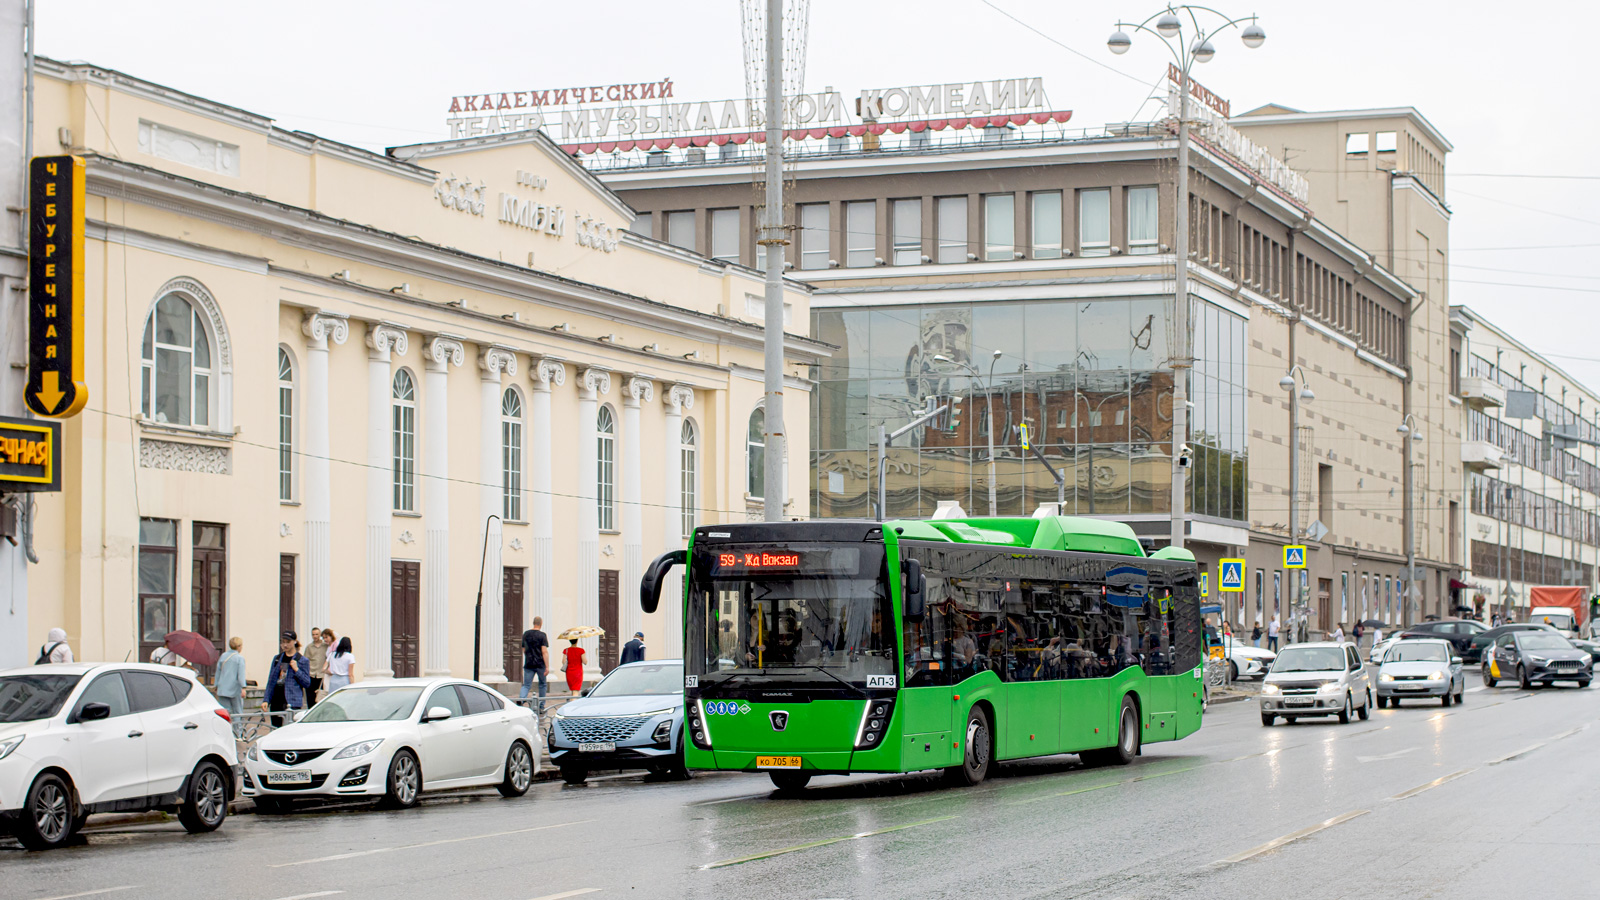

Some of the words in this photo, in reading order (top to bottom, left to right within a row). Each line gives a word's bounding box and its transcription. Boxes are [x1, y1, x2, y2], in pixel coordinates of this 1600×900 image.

[448, 77, 674, 112] АКАДЕМИЧЕСКИЙ
[860, 77, 1043, 118] КОМЕДИИ
[45, 162, 57, 359] ЧЕБУРЕЧНАЯ
[720, 554, 735, 566] 59
[745, 553, 760, 567] Жд
[762, 552, 798, 566] Вокзал
[869, 676, 894, 686] АП-3
[773, 757, 787, 766] 705
